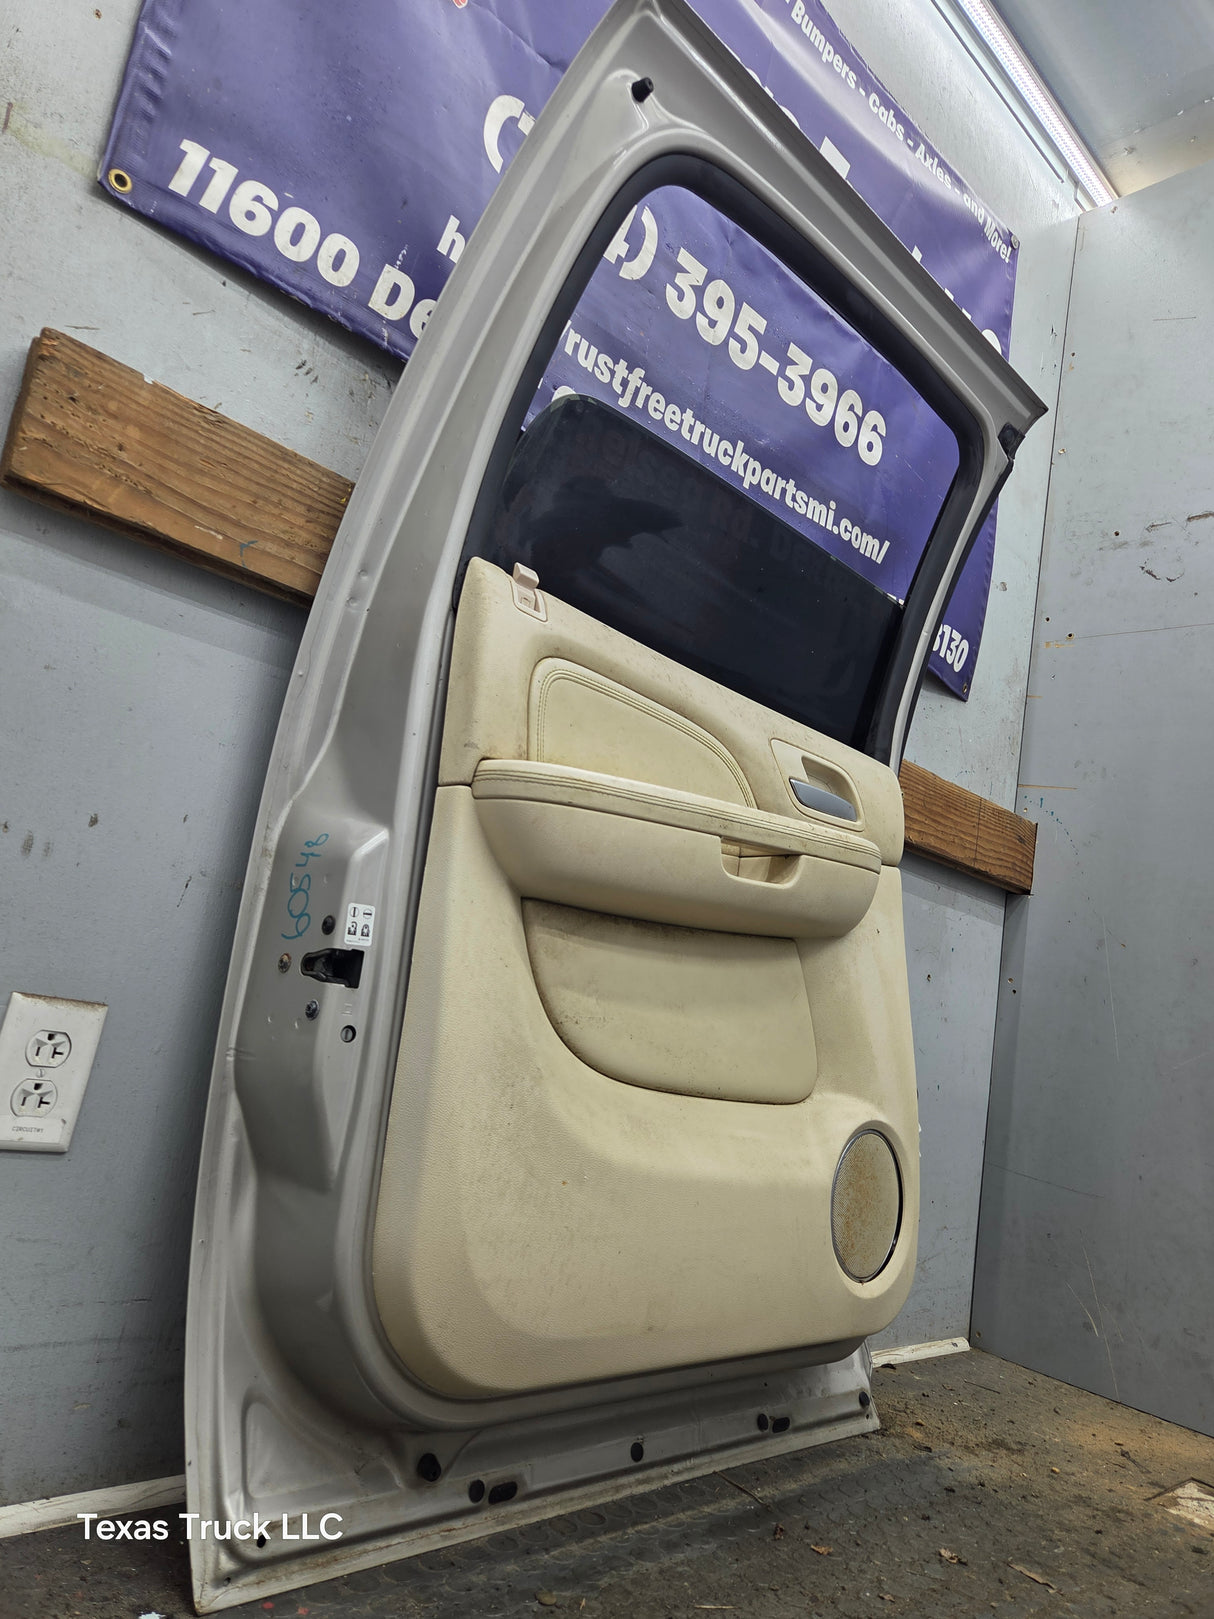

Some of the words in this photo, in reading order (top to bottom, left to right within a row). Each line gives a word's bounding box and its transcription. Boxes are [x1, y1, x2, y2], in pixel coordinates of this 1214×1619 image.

[168, 139, 360, 287] 11600
[791, 0, 857, 89] Bumpers
[868, 92, 905, 142] Cabs
[915, 143, 951, 190] Axles
[962, 193, 985, 225] and
[983, 215, 1013, 264] More!
[666, 247, 887, 466] 395-3966
